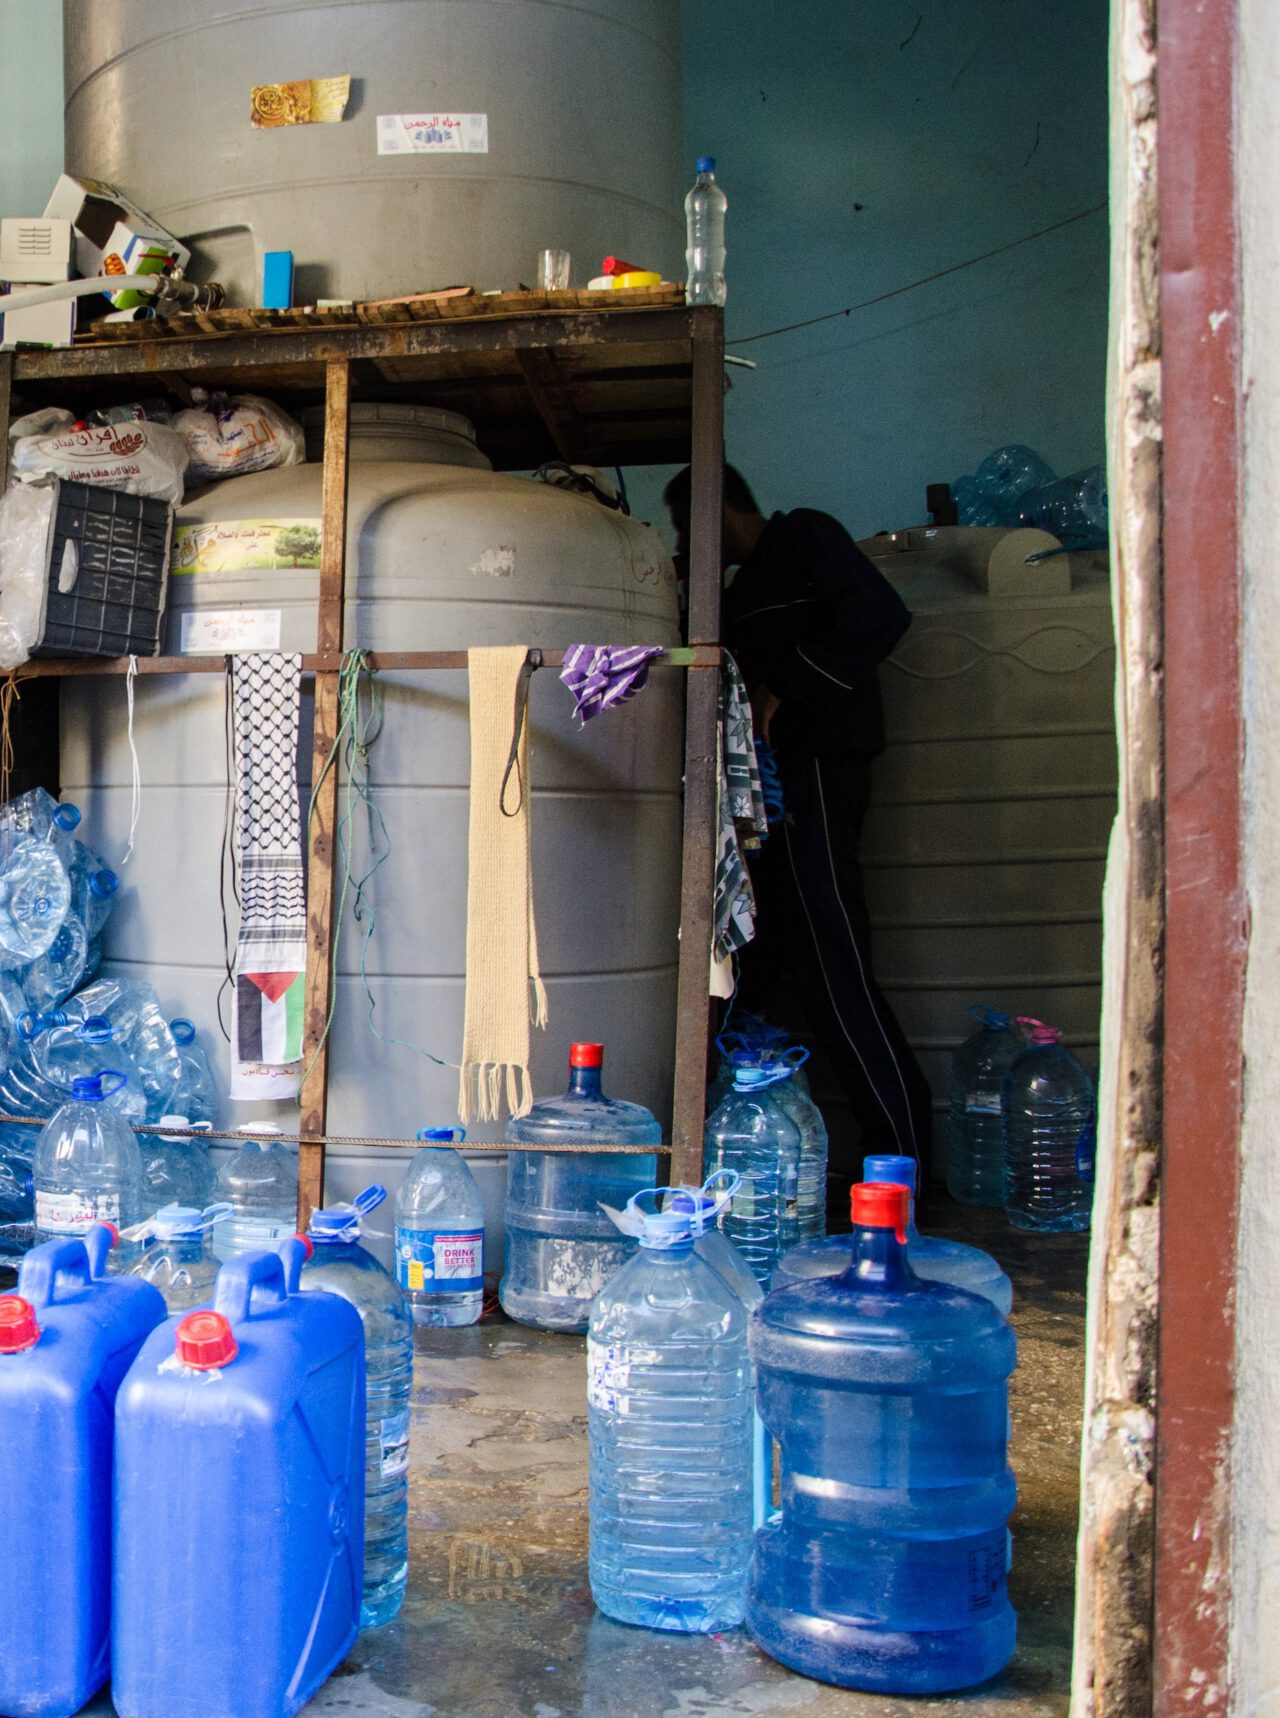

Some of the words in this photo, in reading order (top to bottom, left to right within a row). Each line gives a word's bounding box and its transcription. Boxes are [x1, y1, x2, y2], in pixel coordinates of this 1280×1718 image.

[404, 116, 439, 130] الرحمن
[442, 115, 461, 128] مياه
[444, 1249, 475, 1257] DRINK
[444, 1257, 475, 1265] BETTER
